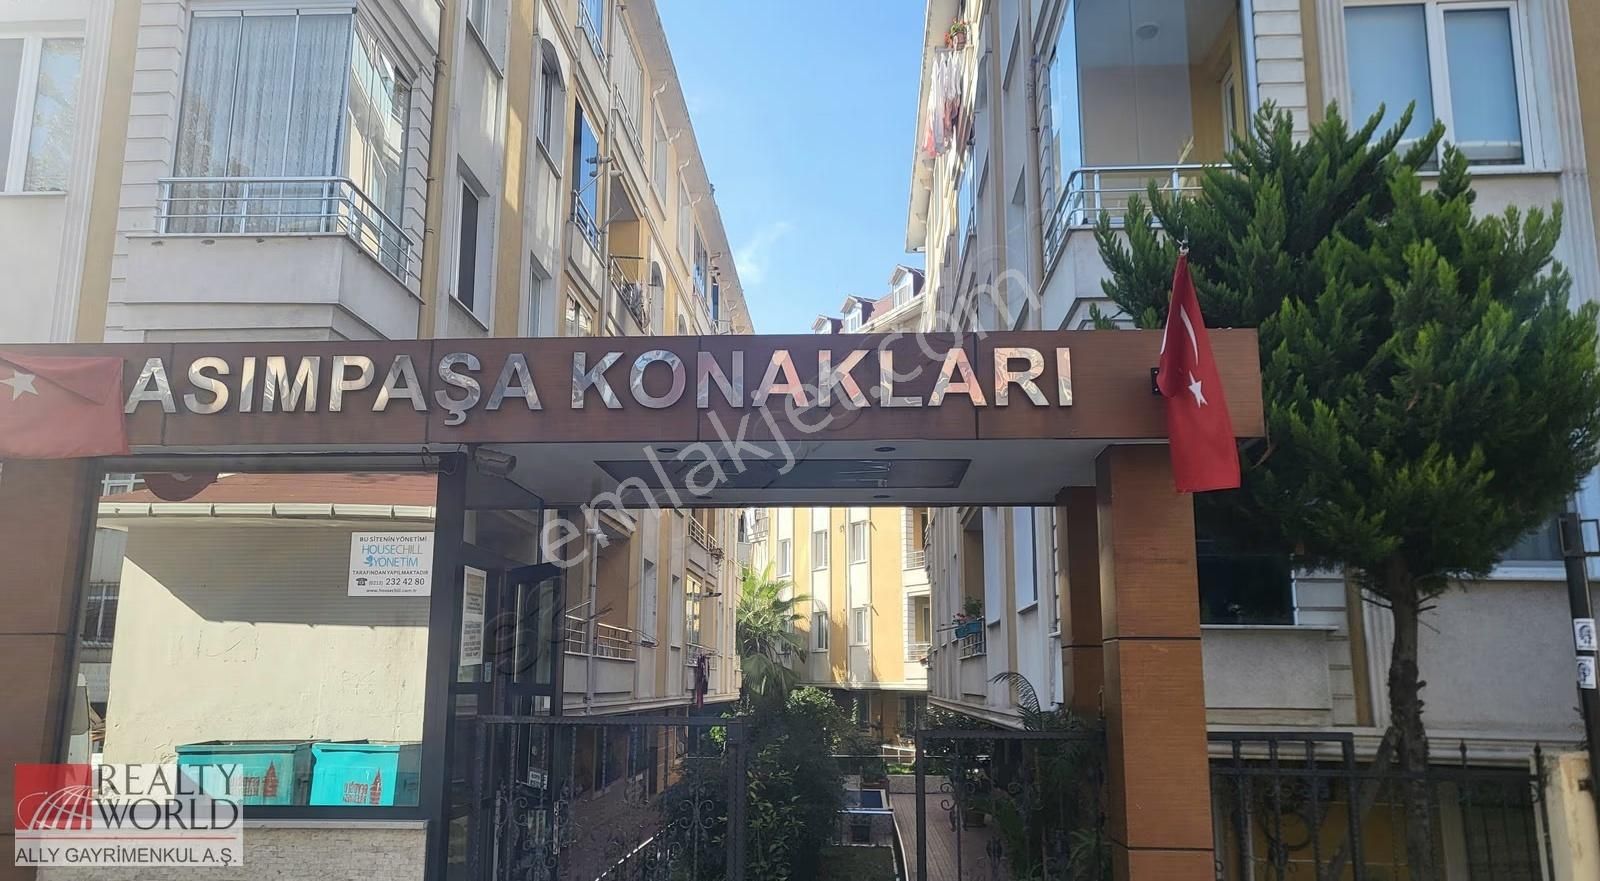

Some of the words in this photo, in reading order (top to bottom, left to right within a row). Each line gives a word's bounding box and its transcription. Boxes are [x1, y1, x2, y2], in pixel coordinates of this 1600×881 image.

[571, 347, 1073, 410] KONAKLARI
[361, 544, 424, 555] HOUSECHILL
[373, 556, 418, 567] YÖNETİM
[385, 577, 401, 586] 232
[402, 577, 413, 586] 42
[414, 577, 425, 586] 80
